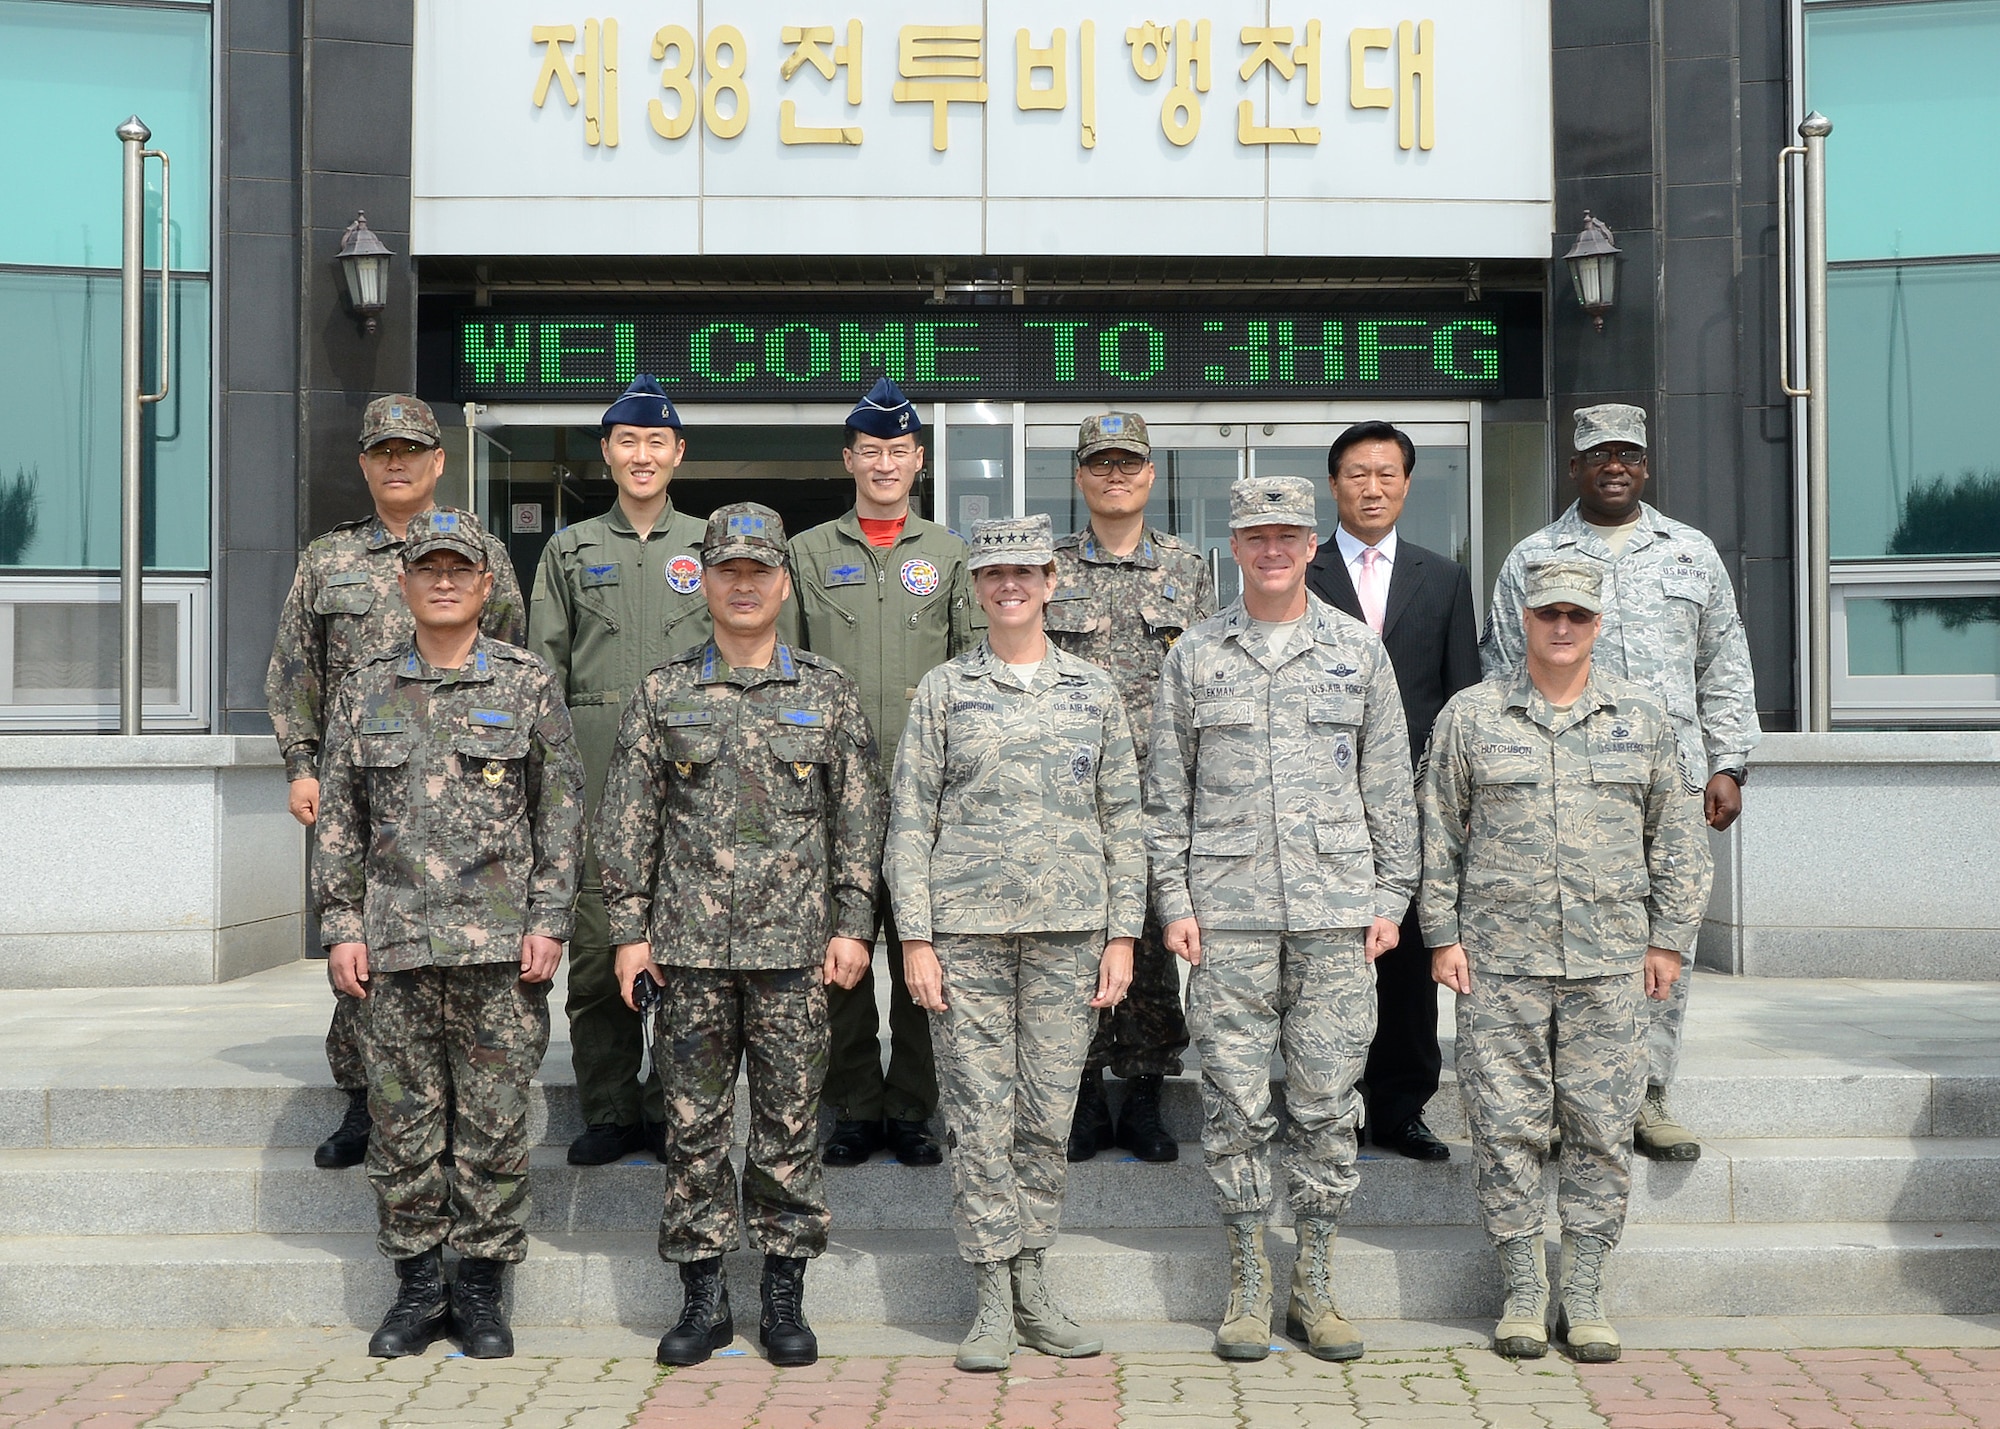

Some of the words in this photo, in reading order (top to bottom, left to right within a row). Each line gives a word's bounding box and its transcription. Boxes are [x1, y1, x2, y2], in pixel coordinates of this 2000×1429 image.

[532, 17, 1435, 151] 제38전투비행전대
[464, 322, 981, 383] WELCOME
[1024, 322, 1166, 382] TO
